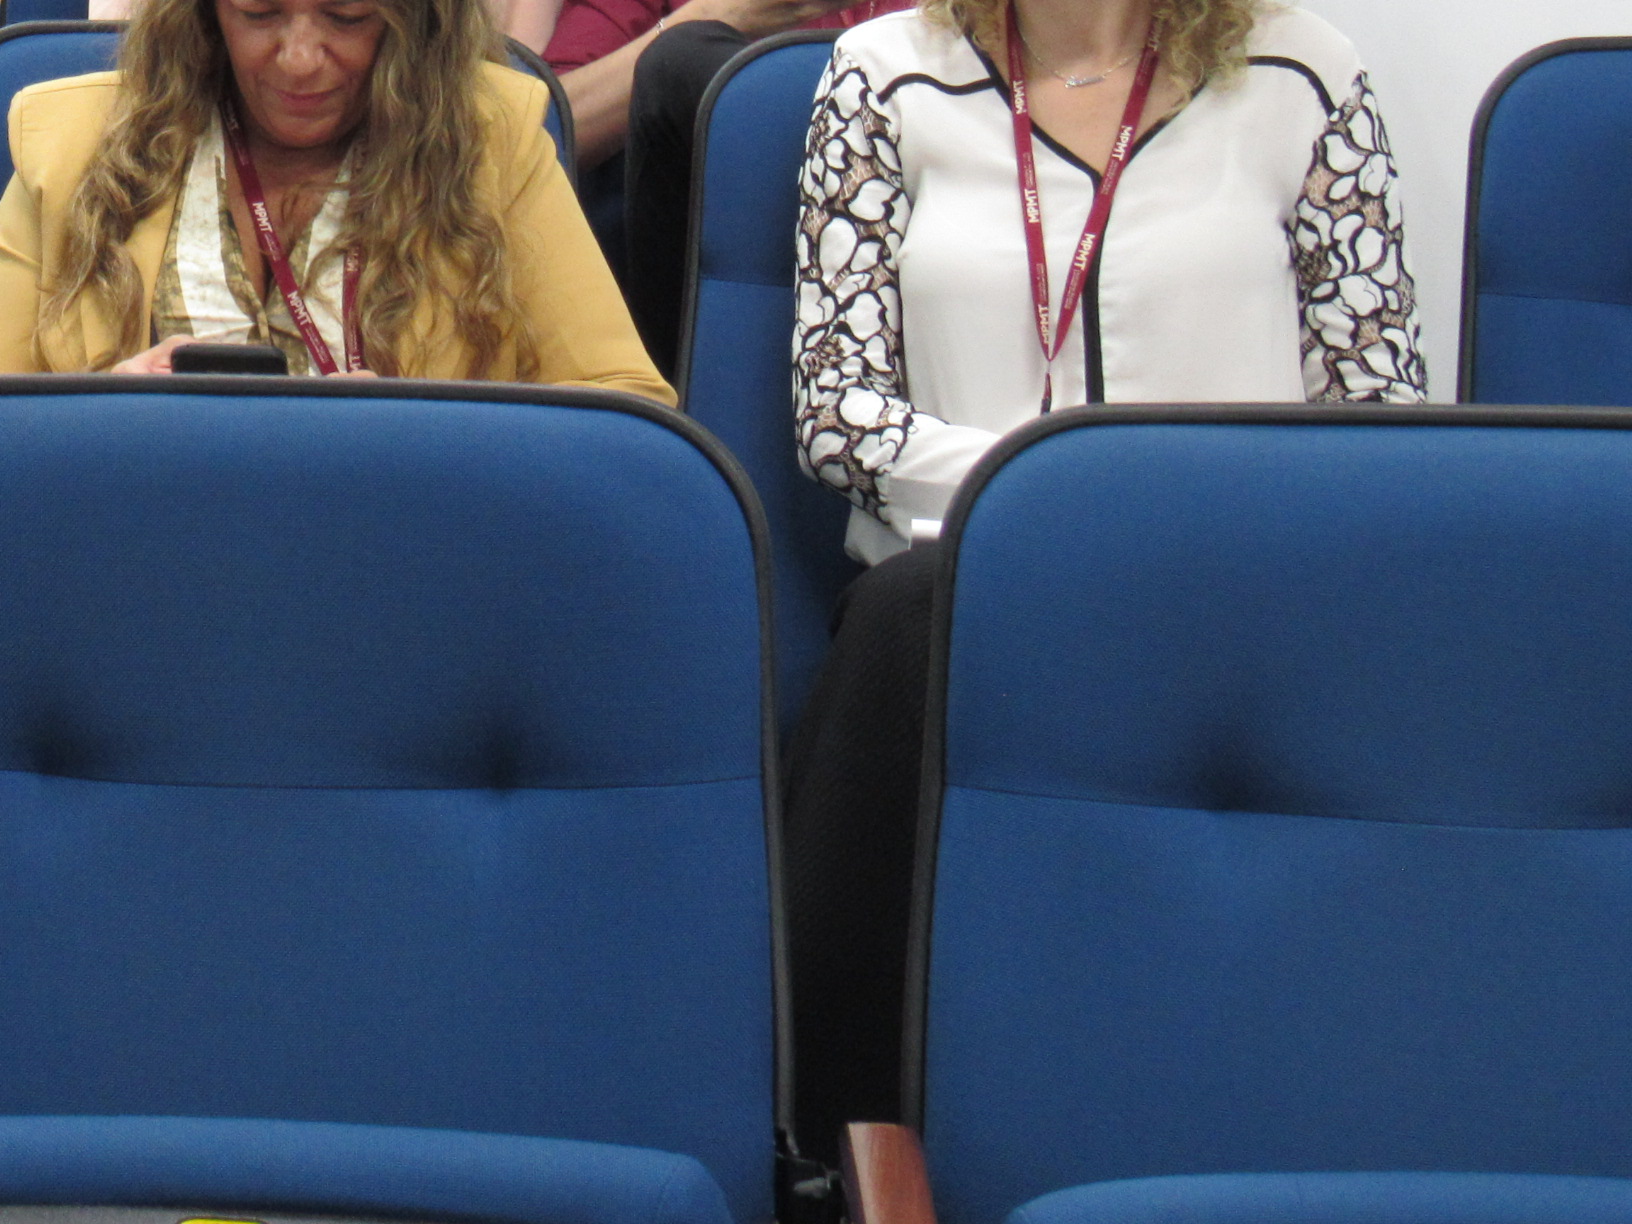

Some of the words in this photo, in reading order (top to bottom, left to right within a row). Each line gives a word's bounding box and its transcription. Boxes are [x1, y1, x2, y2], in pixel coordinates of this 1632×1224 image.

[1013, 80, 1027, 115] MPMT
[1112, 125, 1133, 161] MPMT
[252, 201, 273, 233] MPMT
[1024, 188, 1041, 224] MPMT
[1074, 232, 1096, 271] MPMT
[287, 290, 313, 326] MPMT
[1037, 303, 1050, 345] MPMT
